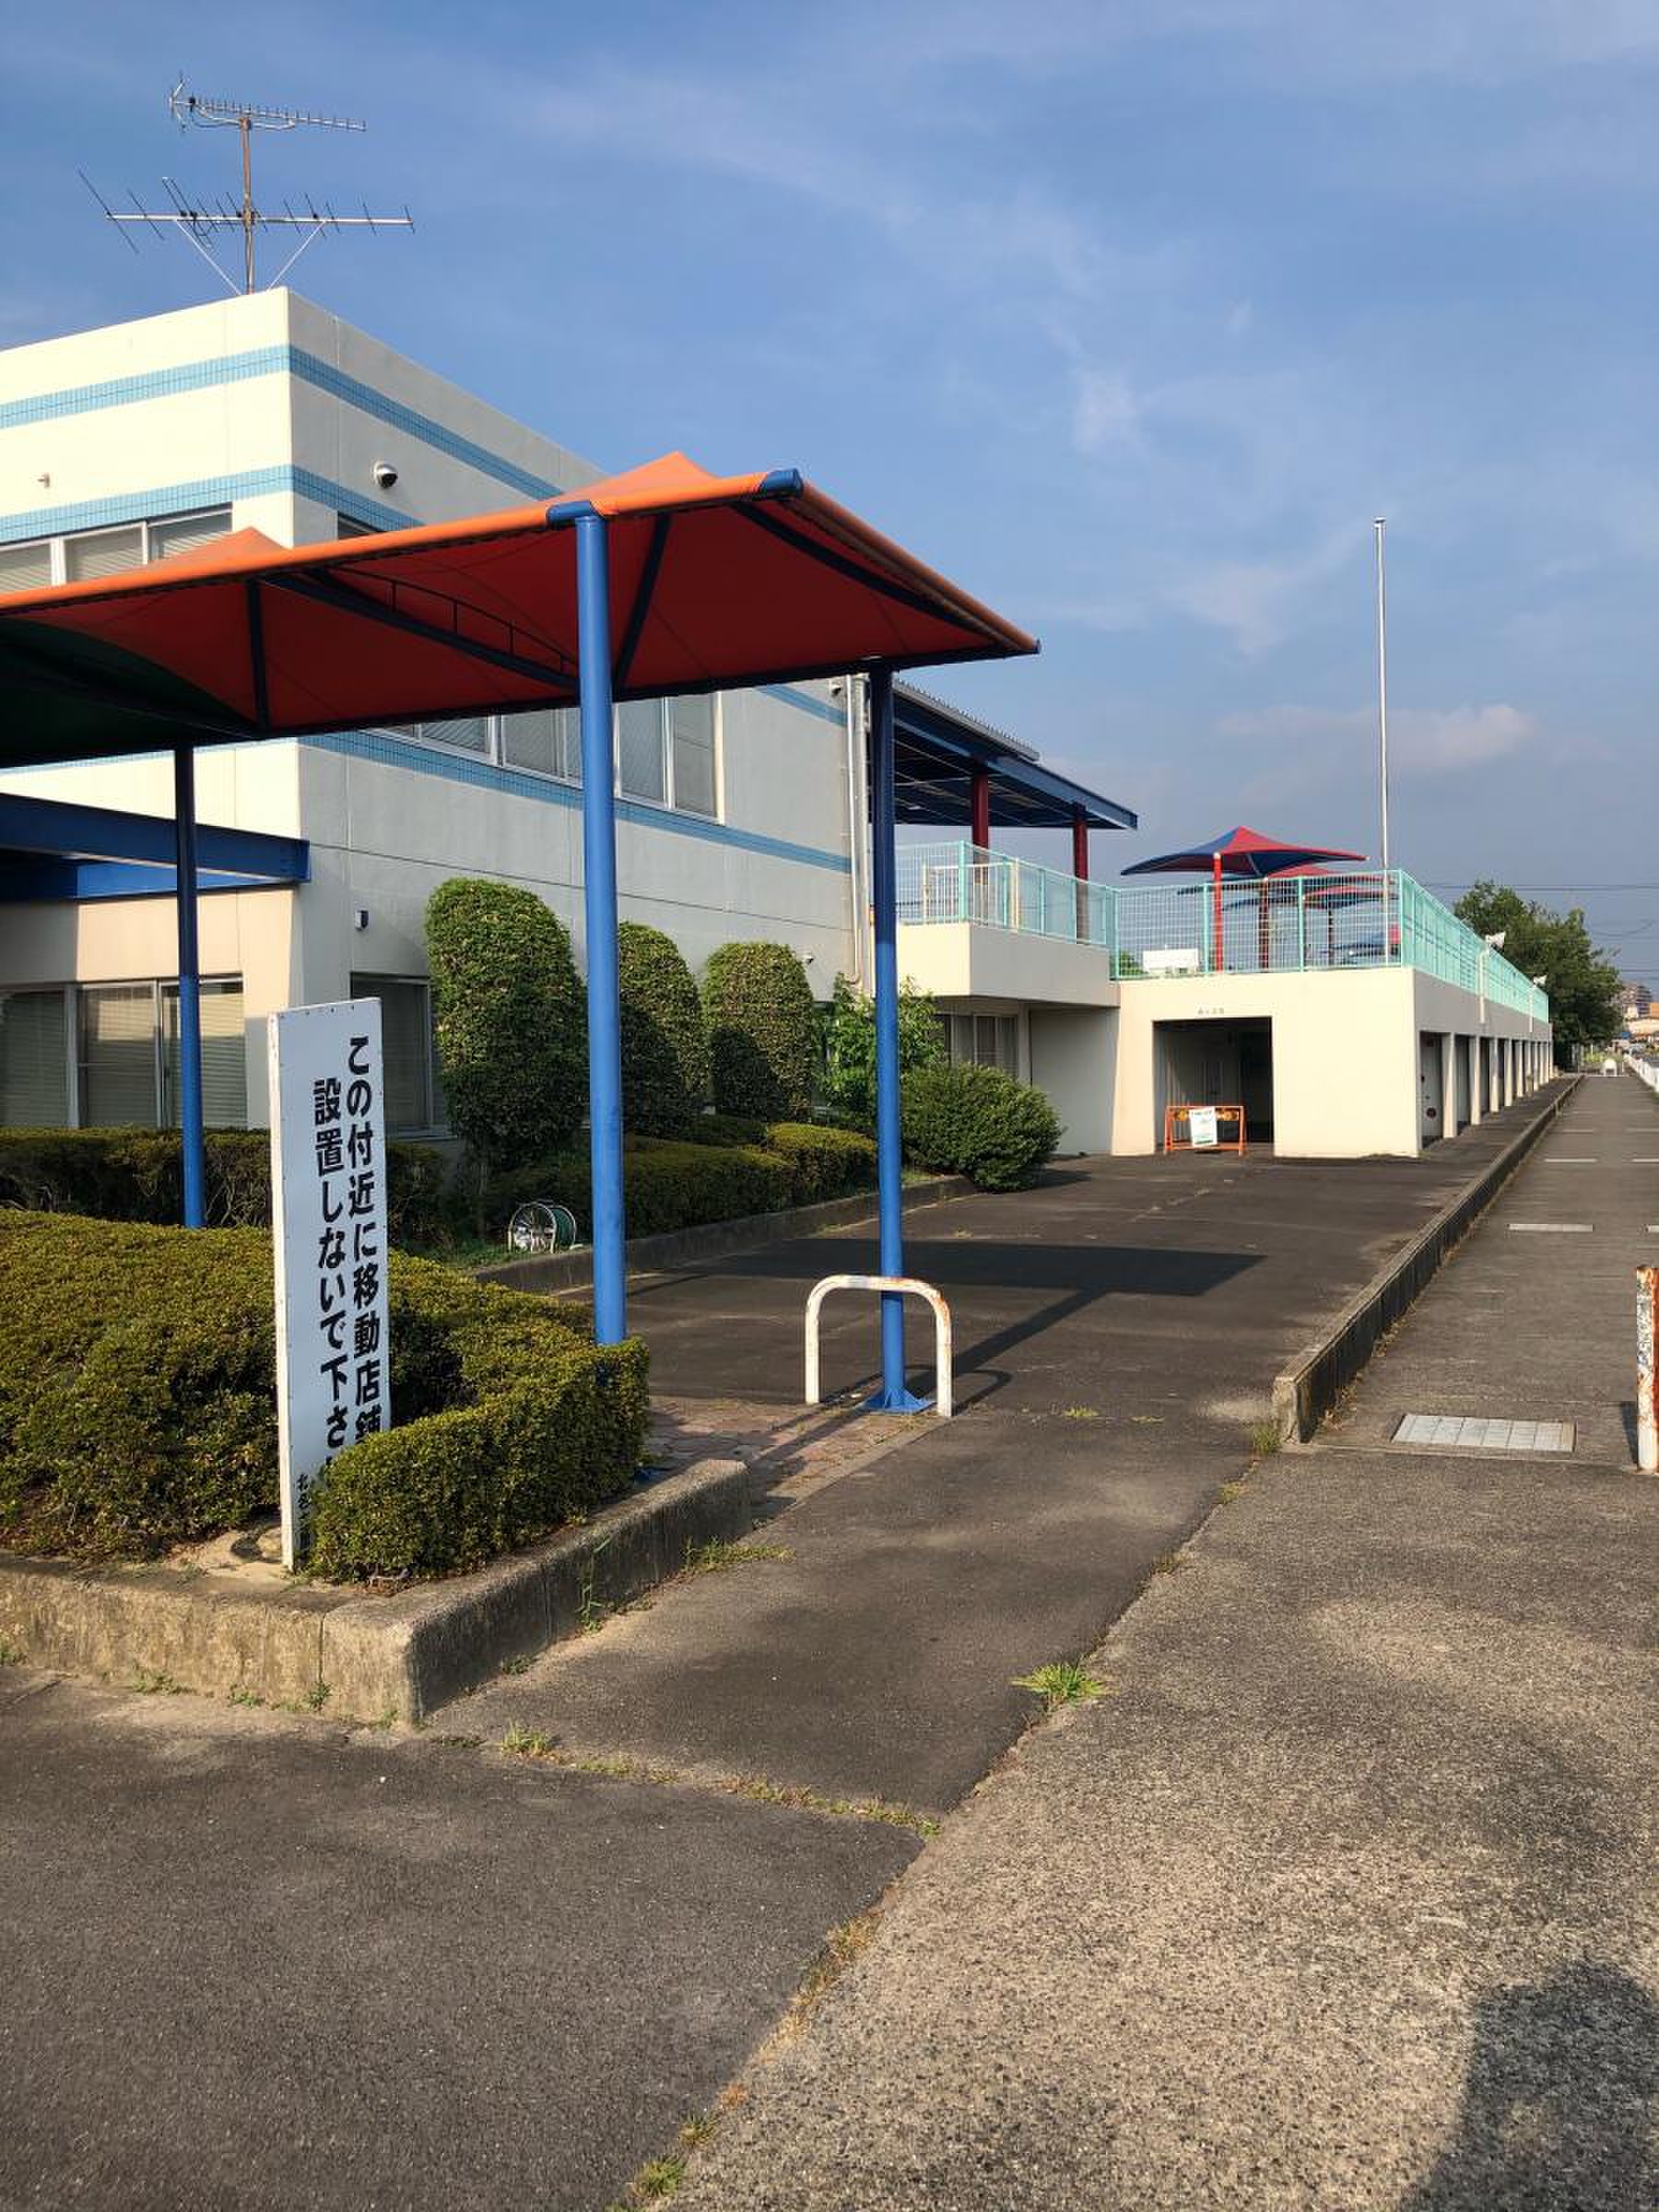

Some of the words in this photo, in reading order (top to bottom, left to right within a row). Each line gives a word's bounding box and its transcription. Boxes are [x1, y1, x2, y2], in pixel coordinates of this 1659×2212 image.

[313, 1077, 347, 1465] 設置しないで下さ
